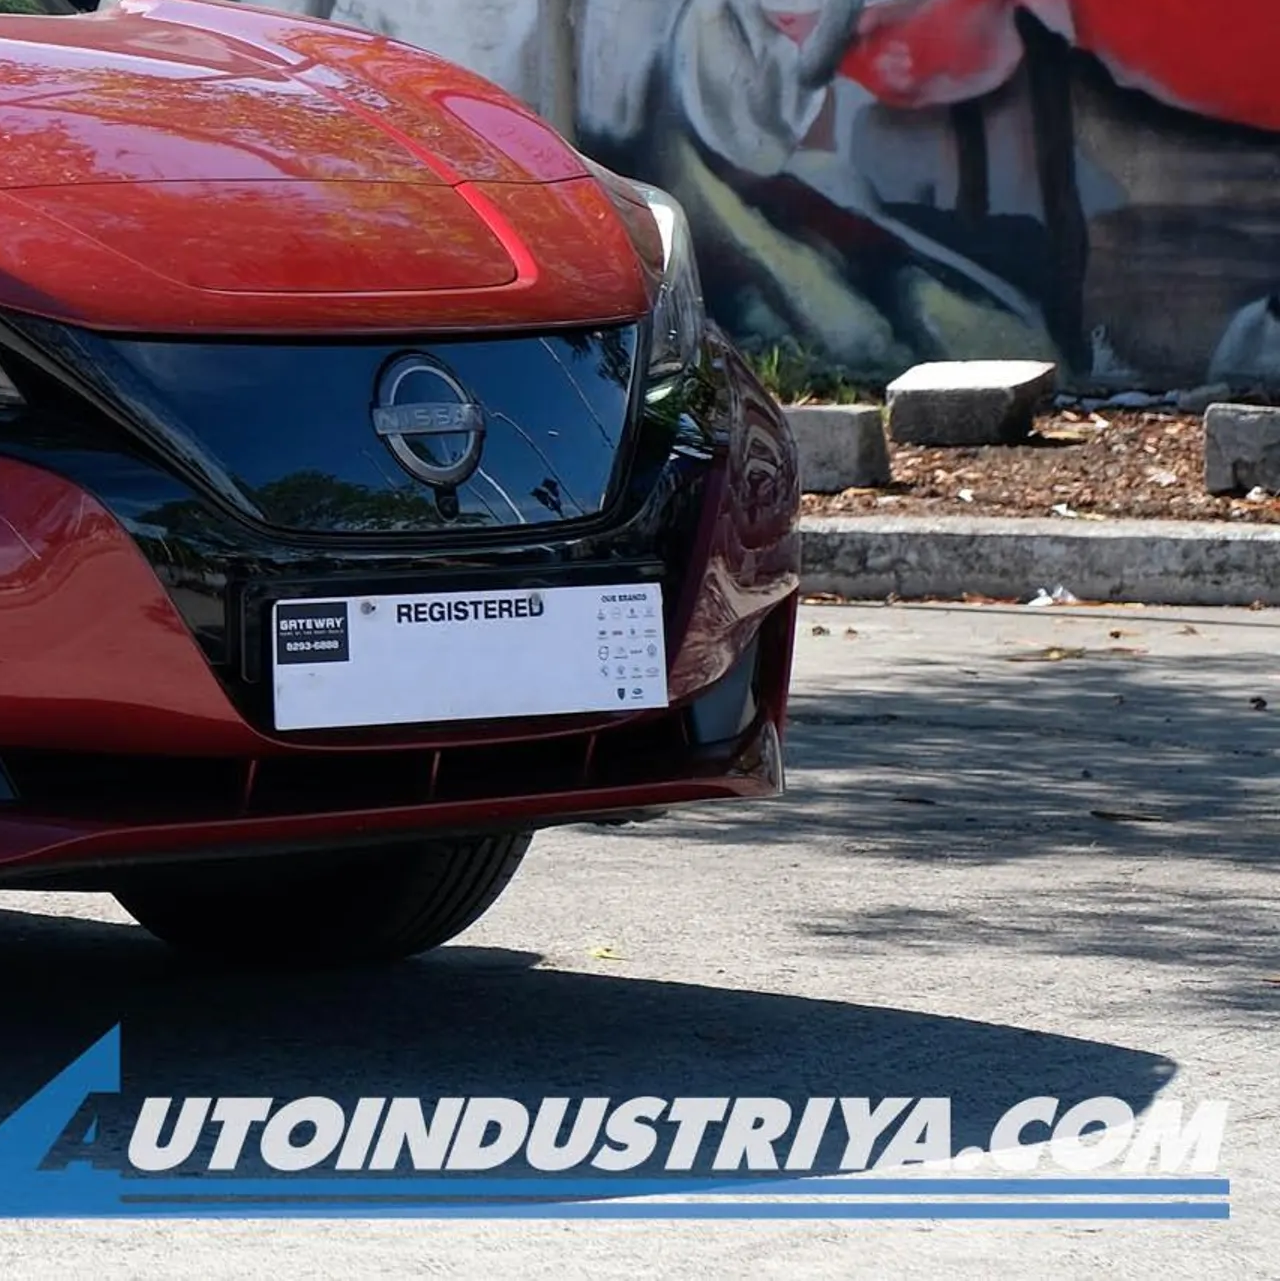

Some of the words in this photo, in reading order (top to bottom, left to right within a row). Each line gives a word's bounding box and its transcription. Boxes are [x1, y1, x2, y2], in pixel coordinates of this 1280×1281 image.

[376, 406, 484, 429] NISSAN
[396, 597, 544, 624] REGISTERED
[280, 617, 344, 631] GATEWAY
